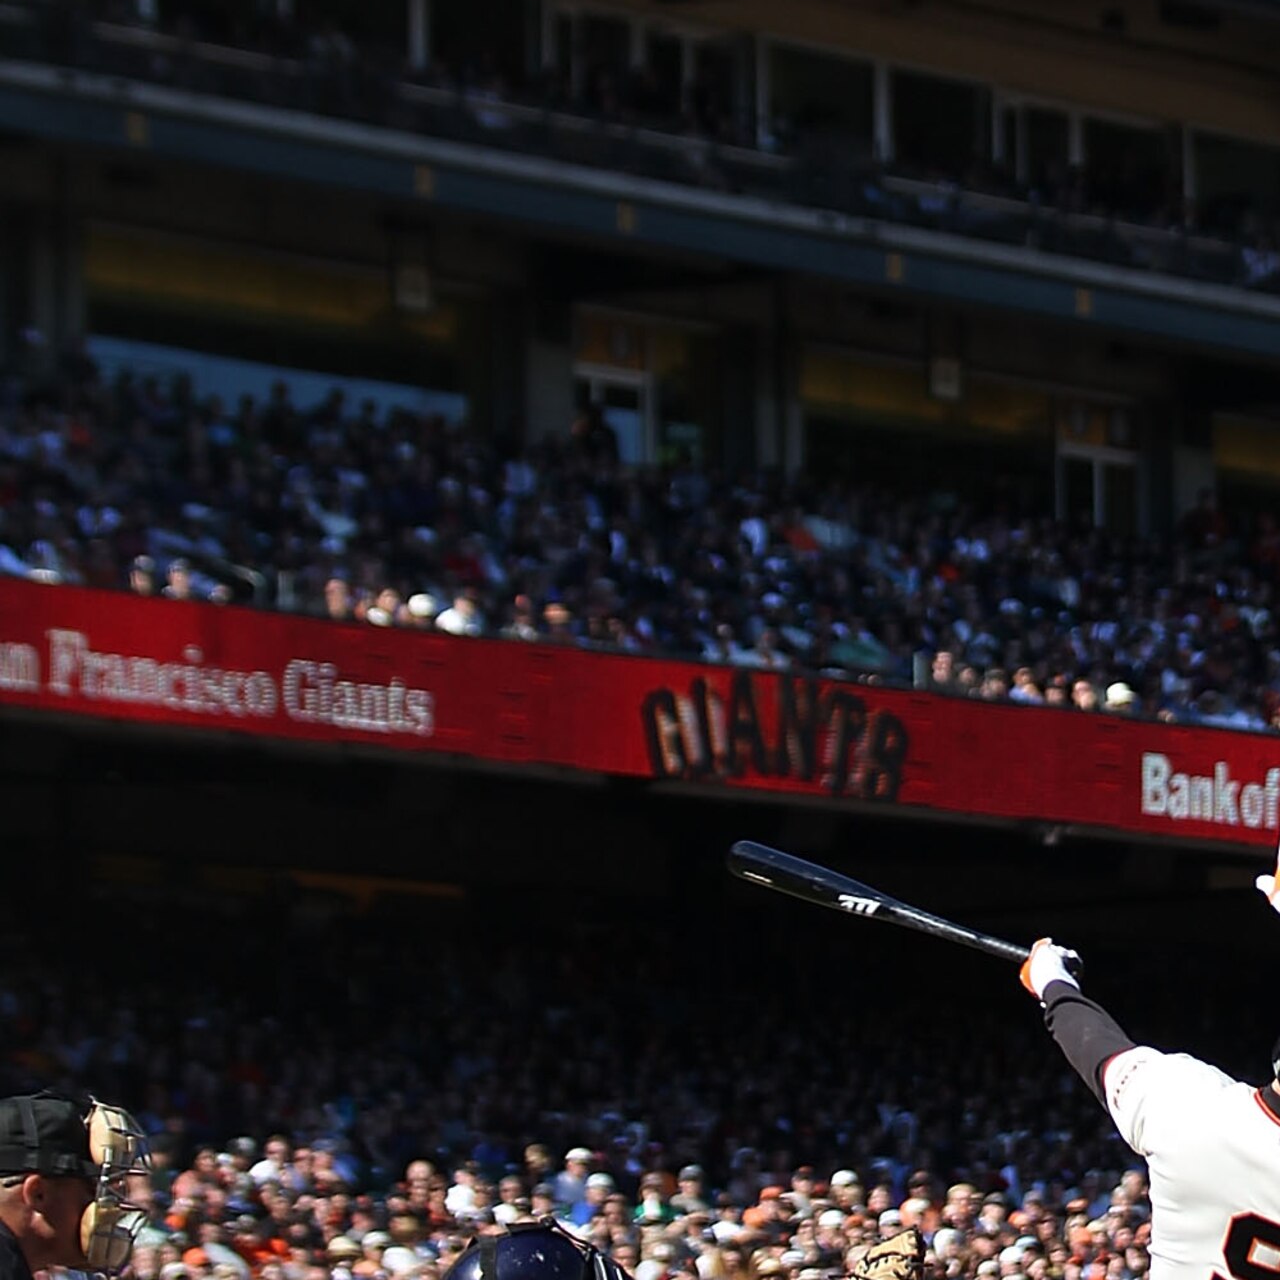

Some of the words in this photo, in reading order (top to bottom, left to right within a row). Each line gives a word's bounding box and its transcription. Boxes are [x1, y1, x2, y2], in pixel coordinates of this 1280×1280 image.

[47, 627, 277, 717] Francisco
[282, 659, 433, 736] Giants
[642, 670, 909, 803] GIANTS
[1142, 752, 1238, 825] Bank
